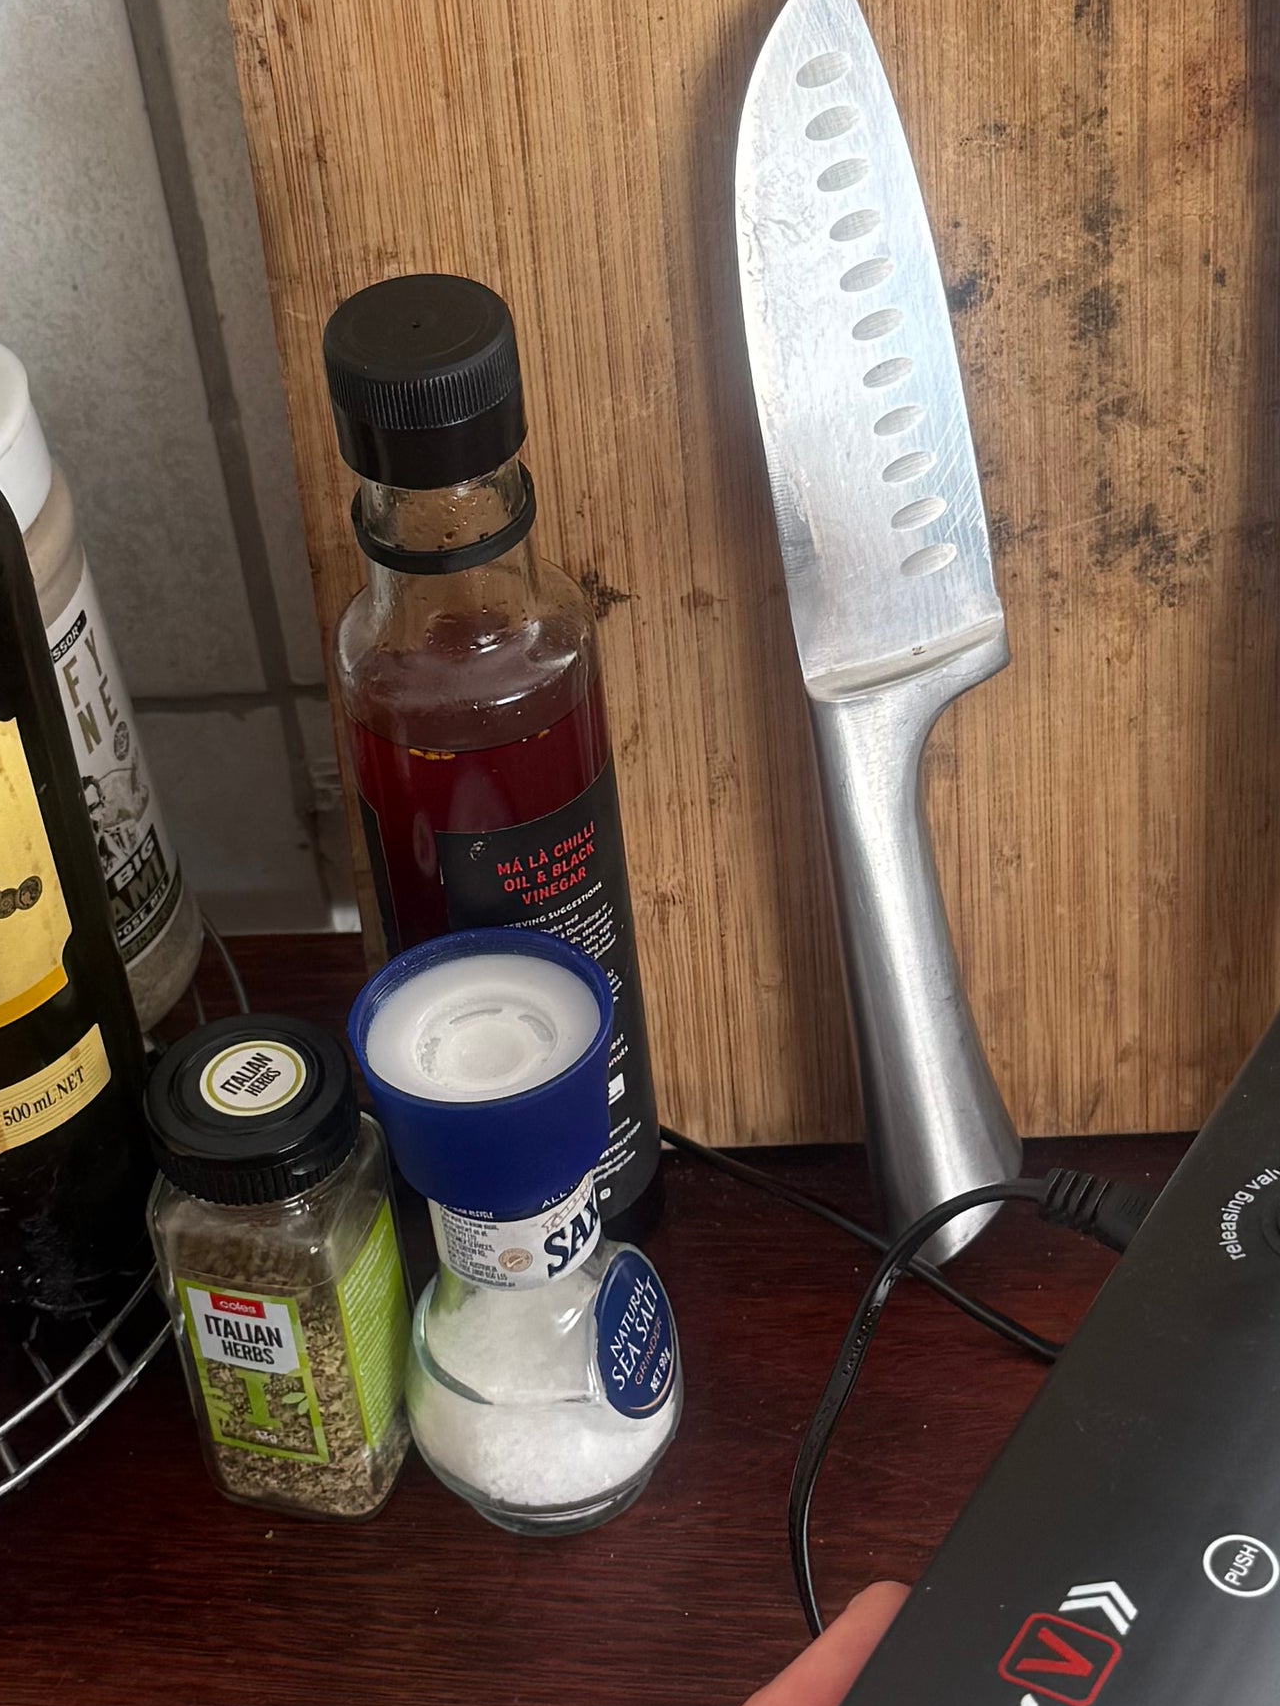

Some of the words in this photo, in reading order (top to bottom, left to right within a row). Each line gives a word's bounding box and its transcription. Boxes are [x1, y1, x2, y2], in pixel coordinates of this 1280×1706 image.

[113, 834, 156, 892] BIG
[496, 856, 523, 876] MÁ
[528, 849, 549, 870] LÀ
[552, 821, 596, 859] CHILLI
[503, 875, 531, 893] OIL
[535, 870, 548, 885] &
[551, 841, 596, 878] BLACK
[521, 866, 588, 907] VINEGAR
[547, 881, 604, 920] SUGGESTIONS
[2, 1102, 32, 1128] 500
[31, 1087, 59, 1116] mL
[55, 1064, 86, 1101] NET
[220, 1052, 273, 1095] ITALIAN
[244, 1066, 282, 1097] HERBS
[1218, 1189, 1256, 1261] releasing
[204, 1313, 284, 1349] ITALIAN
[219, 1300, 258, 1315] coles
[609, 1276, 646, 1359] NATURAL
[221, 1339, 276, 1365] HERBS
[611, 1342, 642, 1391] SEA
[634, 1275, 659, 1343] SALT
[634, 1315, 663, 1387] GRINDER
[1223, 1543, 1260, 1586] PUSH
